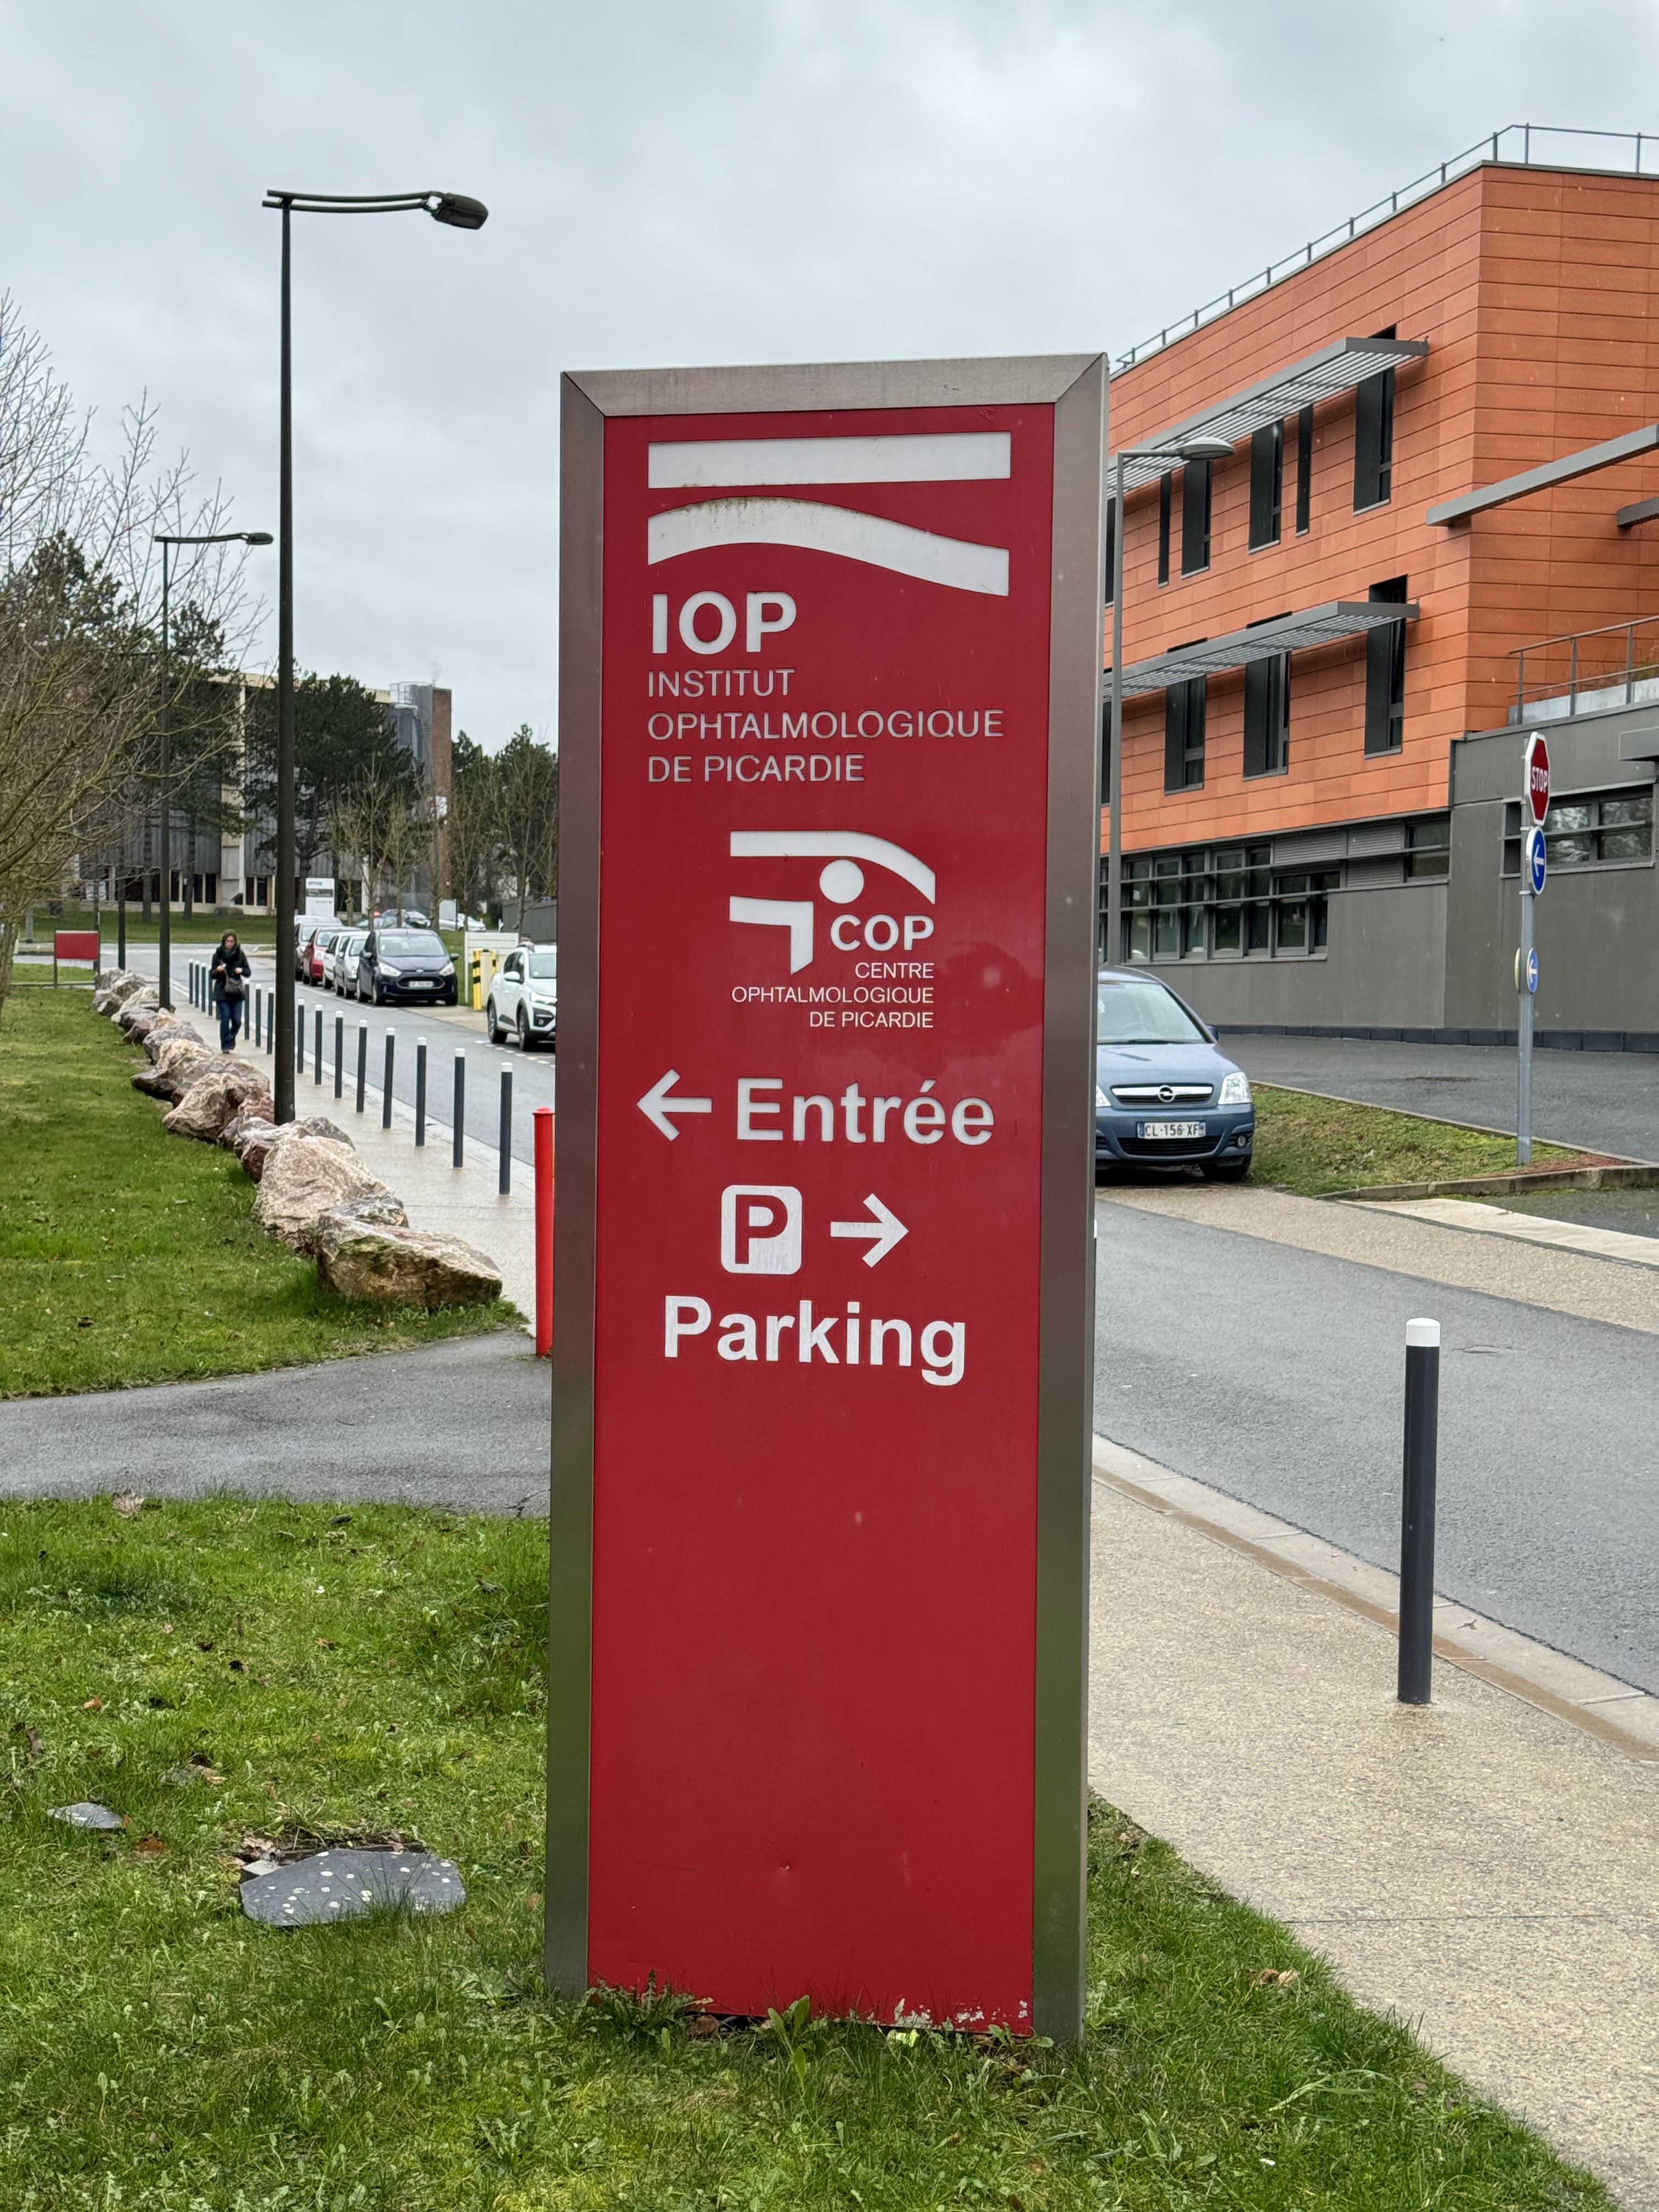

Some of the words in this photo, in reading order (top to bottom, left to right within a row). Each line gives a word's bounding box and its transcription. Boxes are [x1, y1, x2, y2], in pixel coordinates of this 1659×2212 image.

[652, 591, 797, 655] IOP
[648, 668, 795, 697] INSTITUT
[647, 709, 1004, 740] OPHTALMOLOGIQUE
[648, 755, 692, 782] DE
[704, 754, 865, 782] PICARDIE
[1532, 766, 1548, 793] STOP
[830, 914, 934, 951] COP
[855, 962, 935, 979] CENTRE
[731, 986, 934, 1005] OPHTALMOLOGIQUE
[809, 1011, 836, 1027] DE
[842, 1011, 934, 1028] PICARDIE
[736, 1077, 995, 1146] Entrée
[735, 1194, 788, 1265] P
[664, 1295, 966, 1386] Parking
